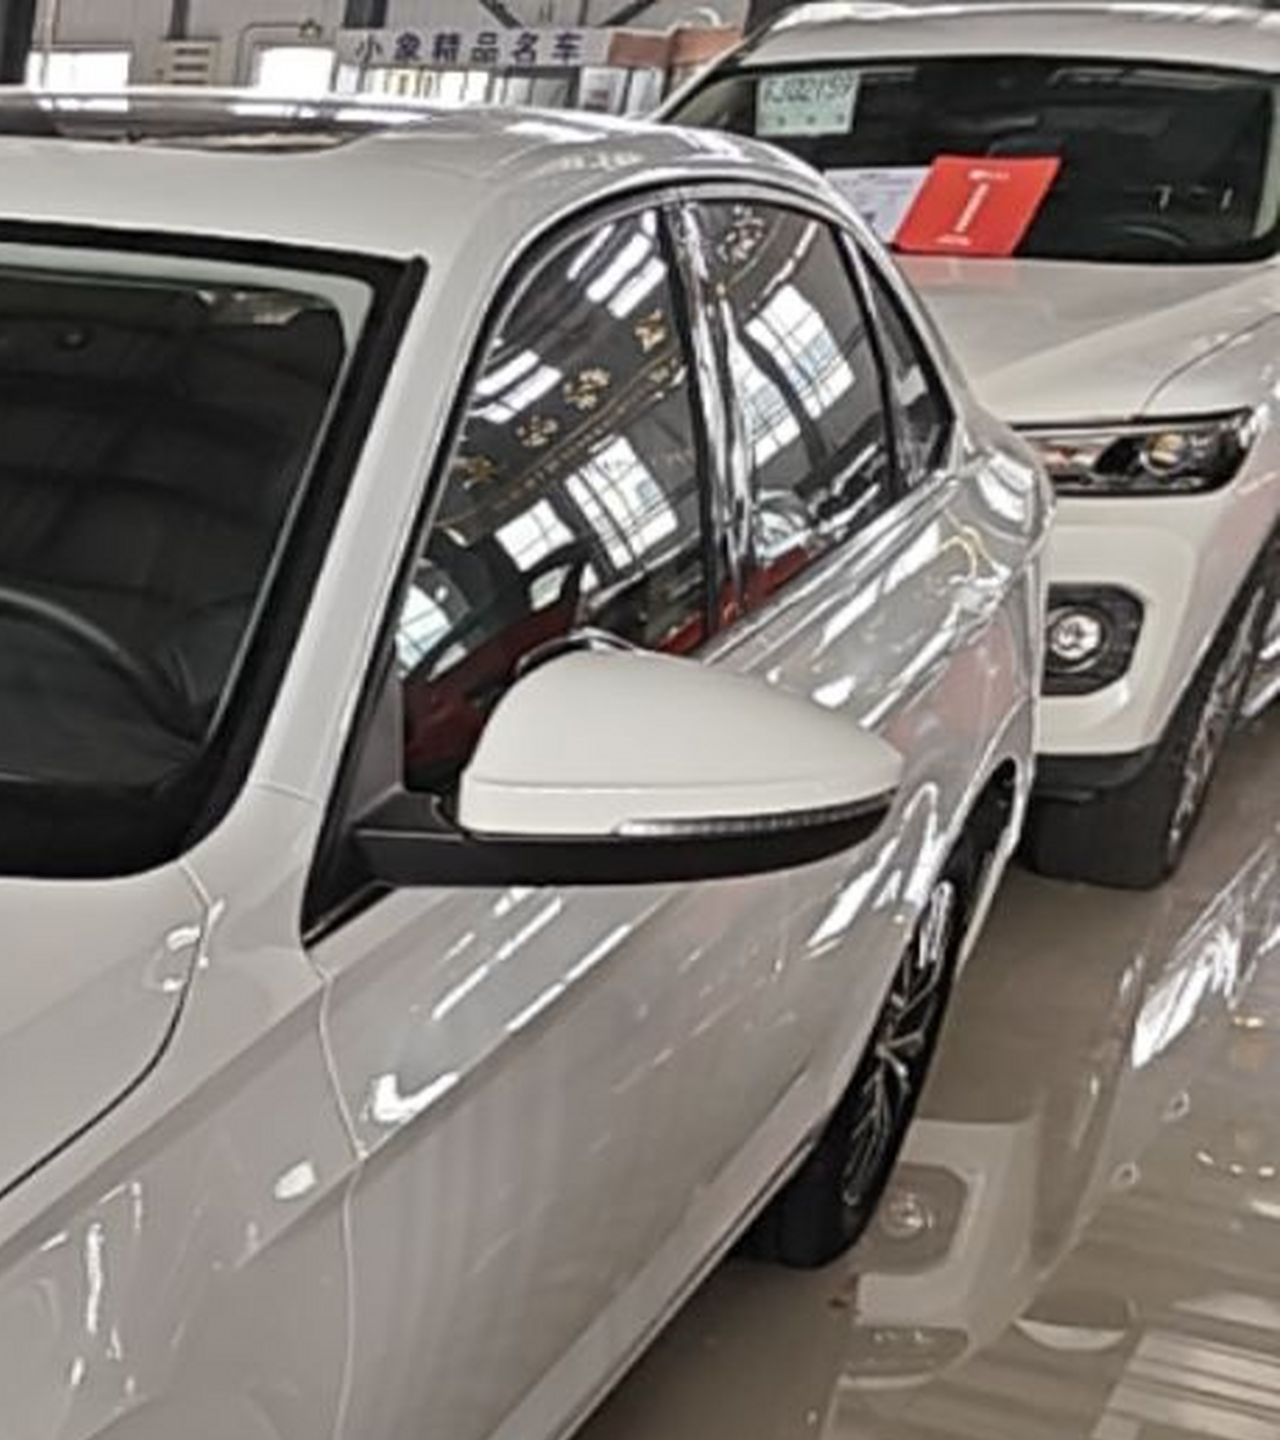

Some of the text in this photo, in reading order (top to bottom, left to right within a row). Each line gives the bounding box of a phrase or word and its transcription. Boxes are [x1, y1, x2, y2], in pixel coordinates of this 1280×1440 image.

[354, 30, 584, 64] 小象精品名车
